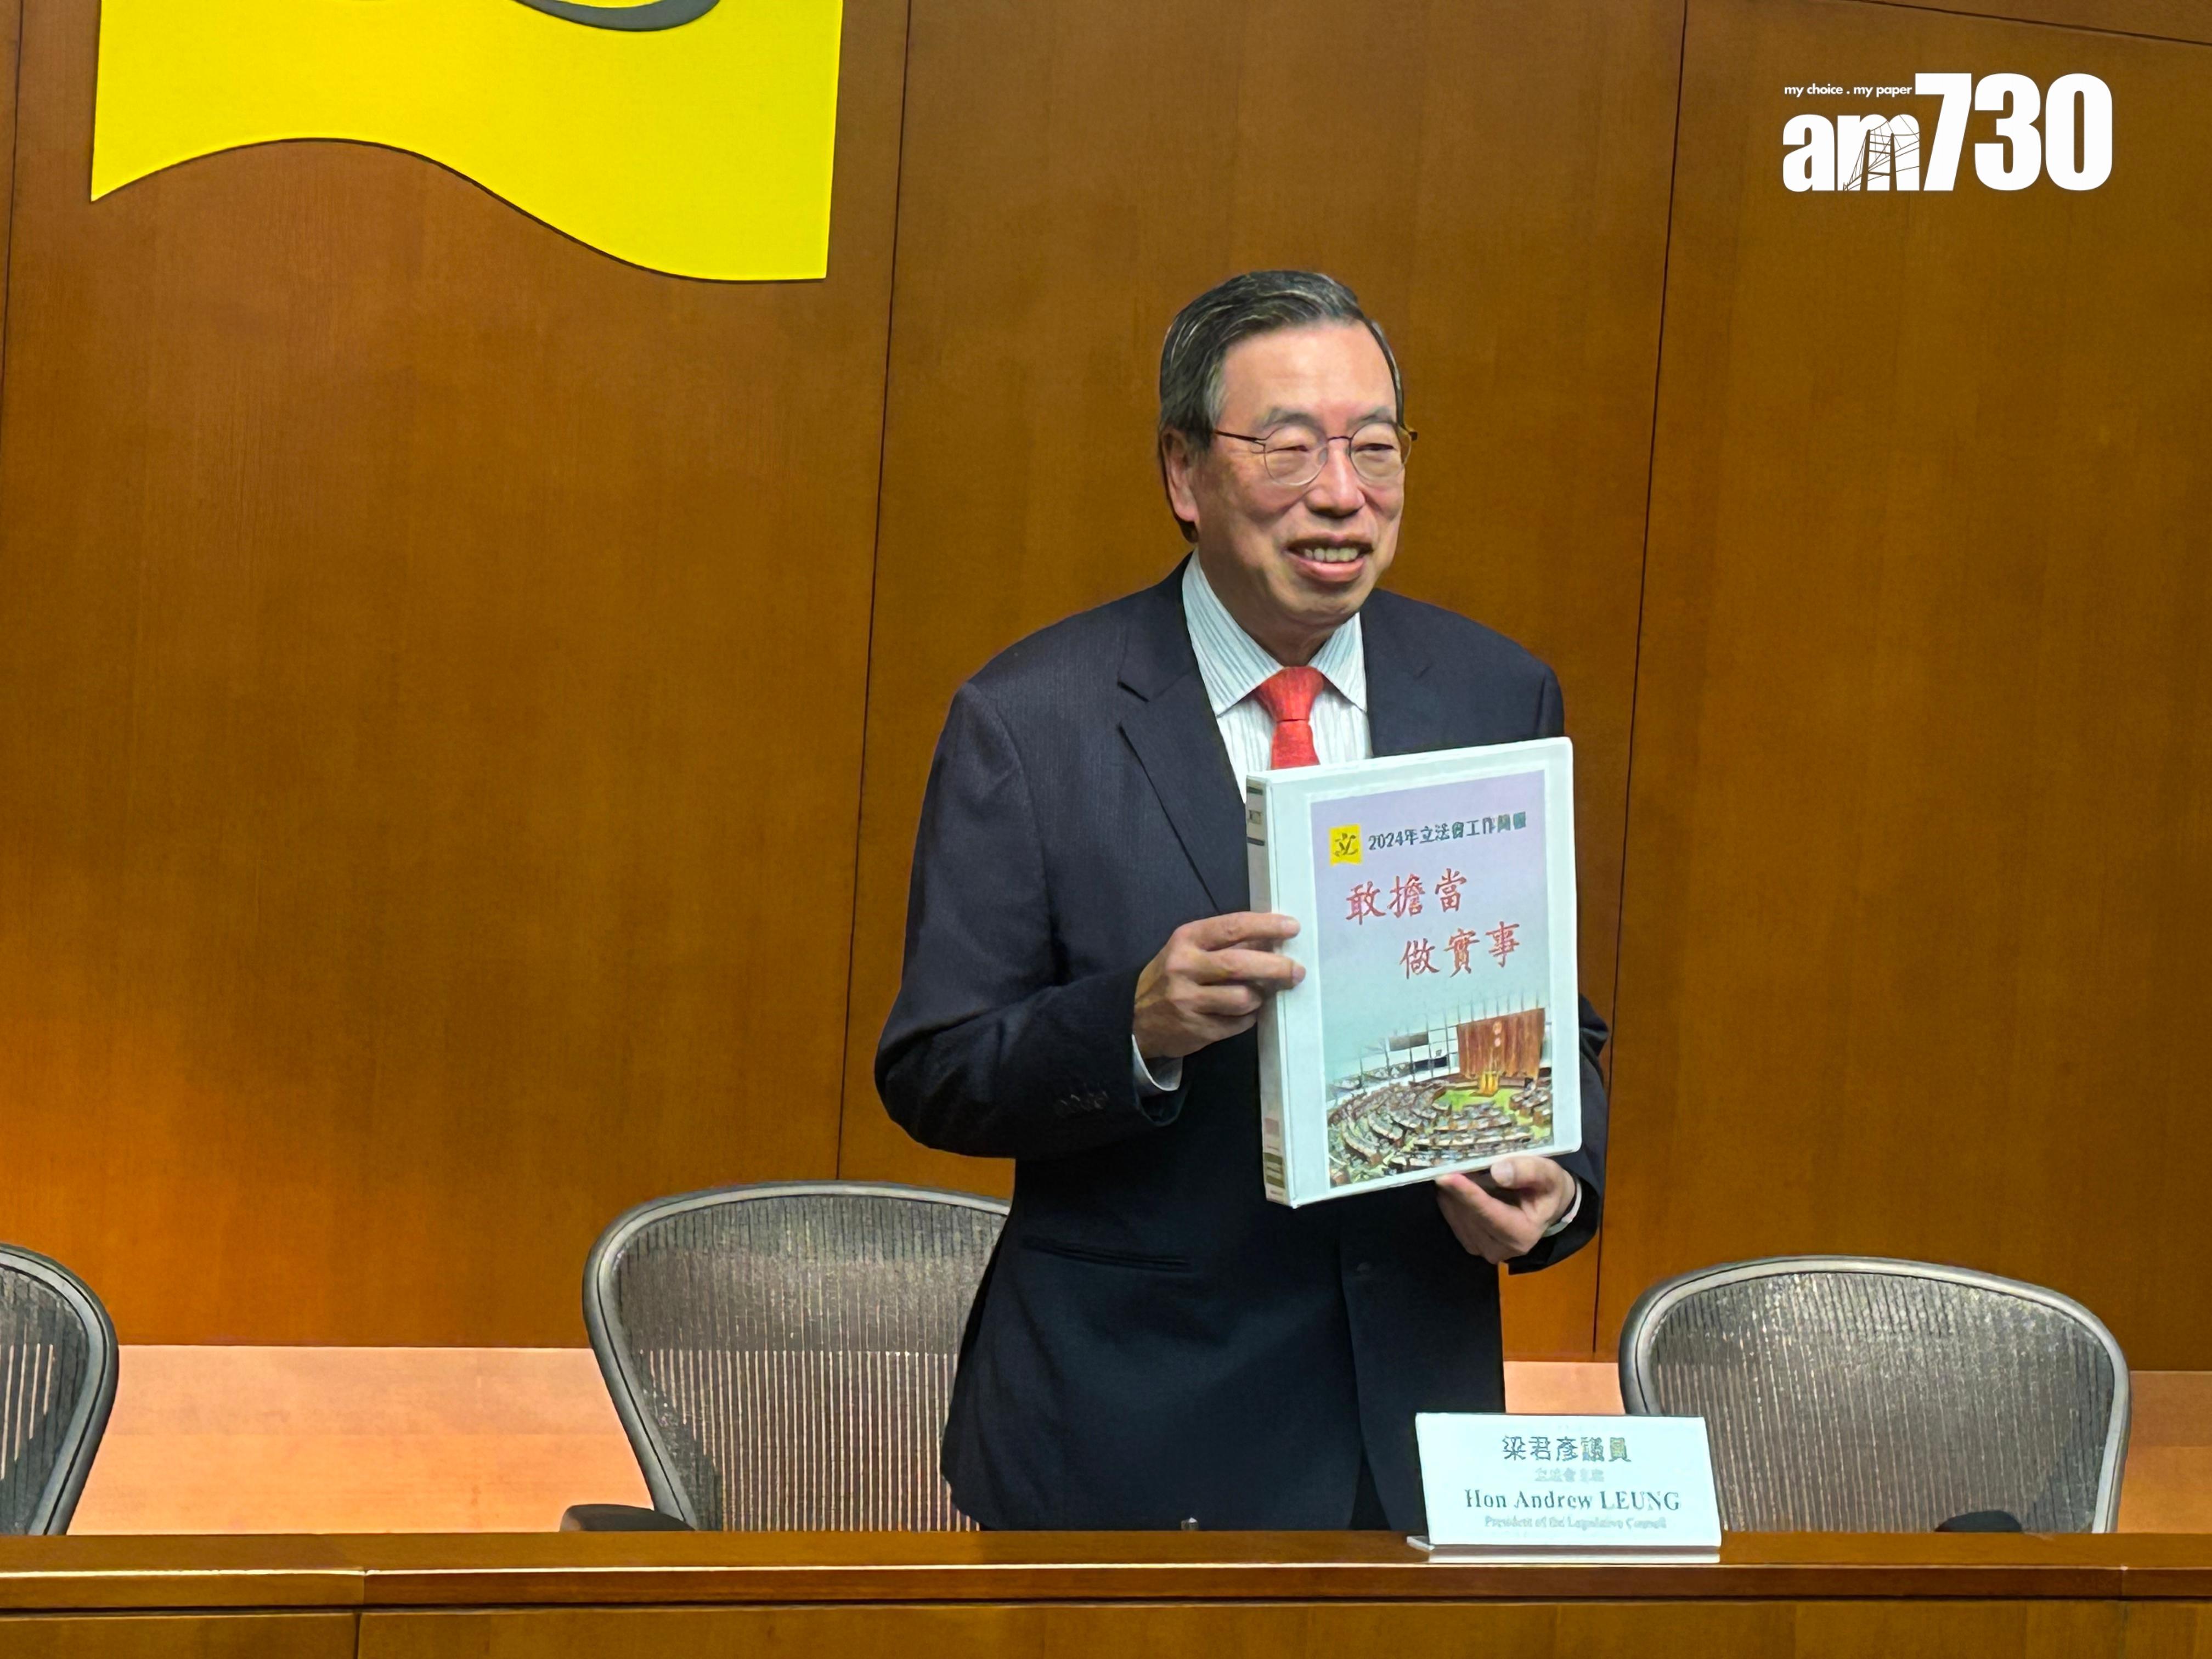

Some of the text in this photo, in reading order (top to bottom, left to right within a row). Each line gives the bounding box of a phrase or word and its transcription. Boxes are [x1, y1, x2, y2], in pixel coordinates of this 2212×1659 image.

[1346, 868, 1467, 924] 敢擔當
[1400, 921, 1520, 979] 做實事
[1464, 1488, 1681, 1511] Hon Andrew LEUNG
